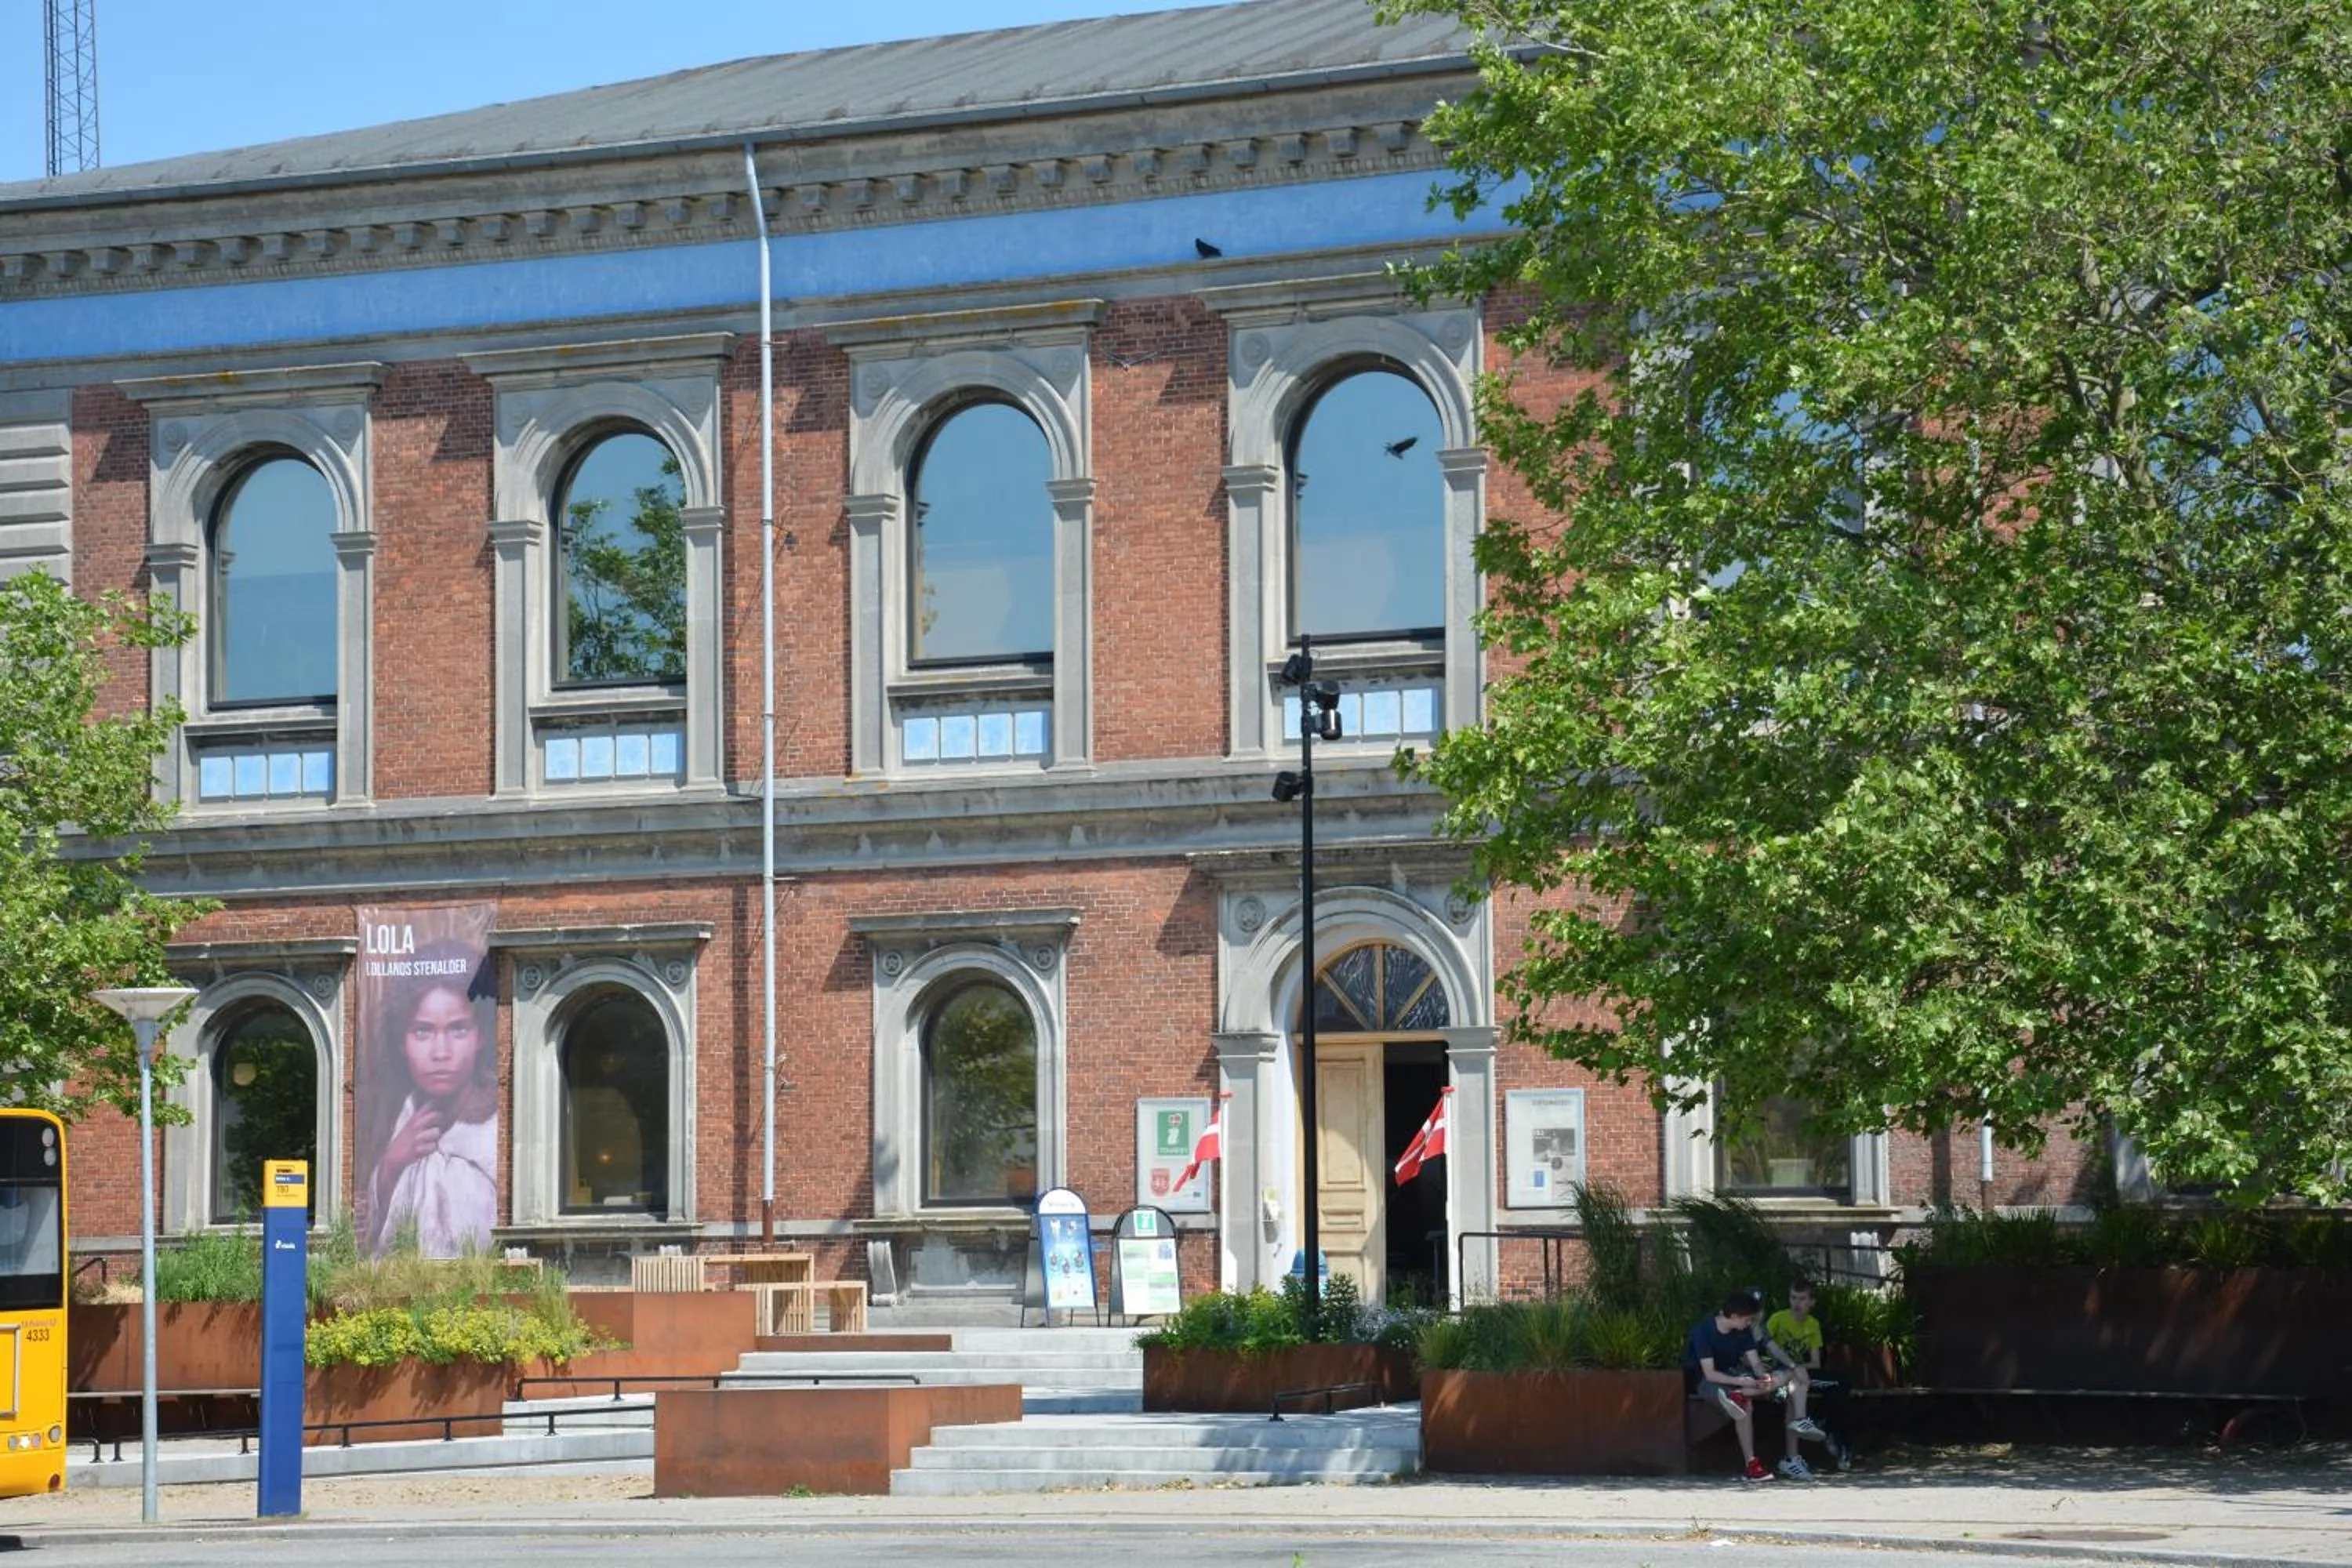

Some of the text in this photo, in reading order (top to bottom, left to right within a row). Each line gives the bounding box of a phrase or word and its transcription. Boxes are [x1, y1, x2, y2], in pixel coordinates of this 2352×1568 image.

[366, 924, 415, 954] LOLA
[366, 959, 466, 976] LOLLANDS STENALDER
[26, 1329, 50, 1341] 4333
